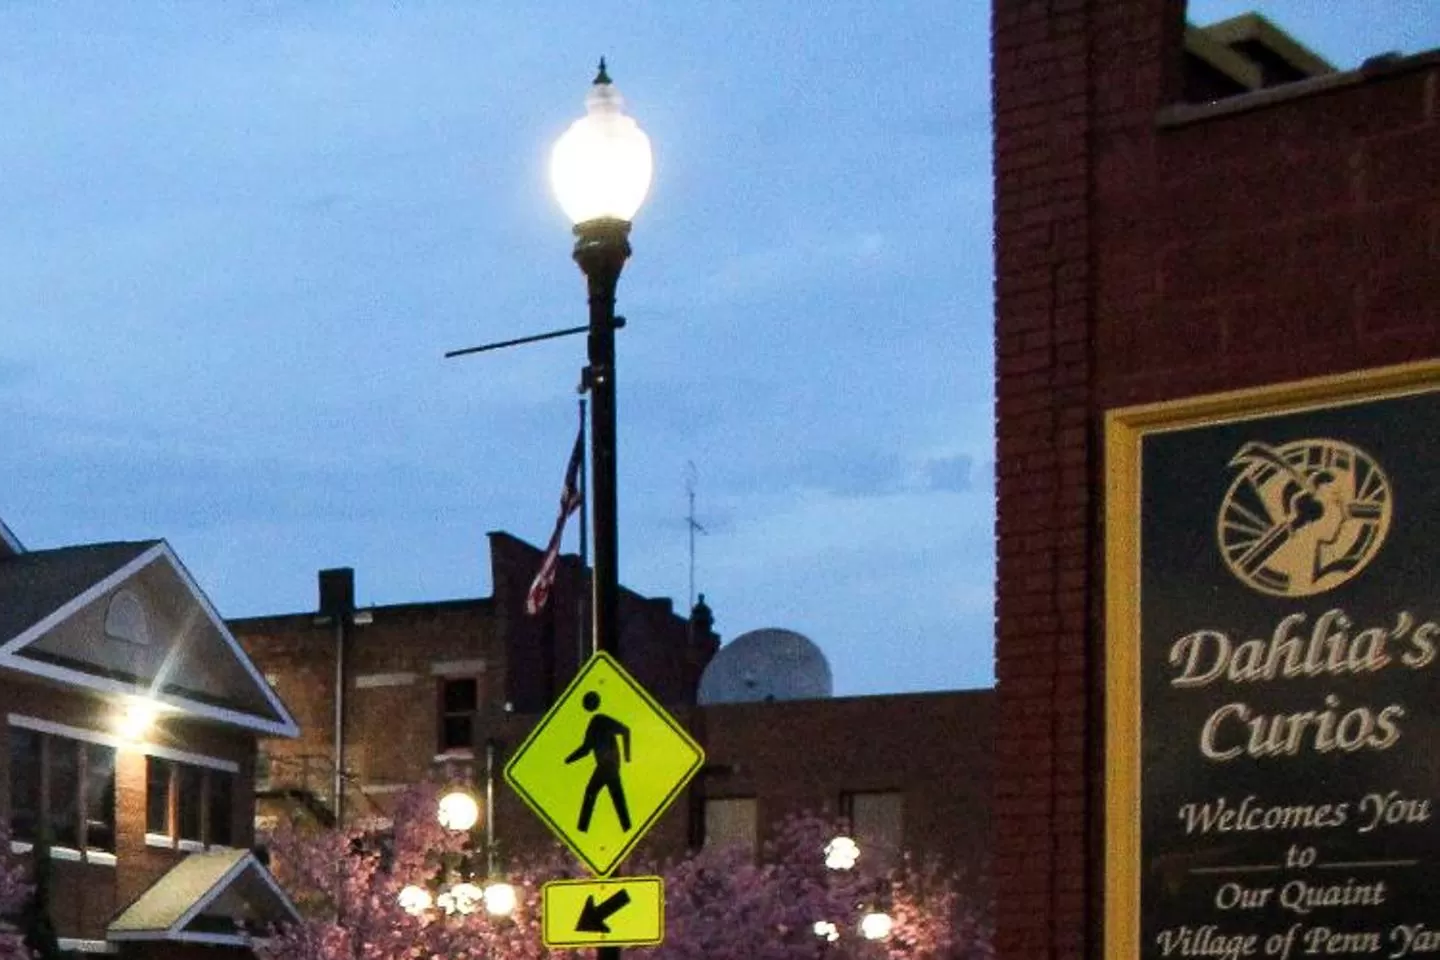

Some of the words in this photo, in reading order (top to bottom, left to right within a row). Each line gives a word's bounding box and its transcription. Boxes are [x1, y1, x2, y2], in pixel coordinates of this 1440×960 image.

[1169, 609, 1440, 688] Dahlia's
[1200, 694, 1405, 762] Curios
[1178, 796, 1349, 834] Welcomes
[1358, 790, 1432, 833] You
[1286, 843, 1317, 868] to
[1216, 882, 1274, 910] Our
[1280, 877, 1388, 913] Quaint
[1304, 925, 1381, 954] Penn
